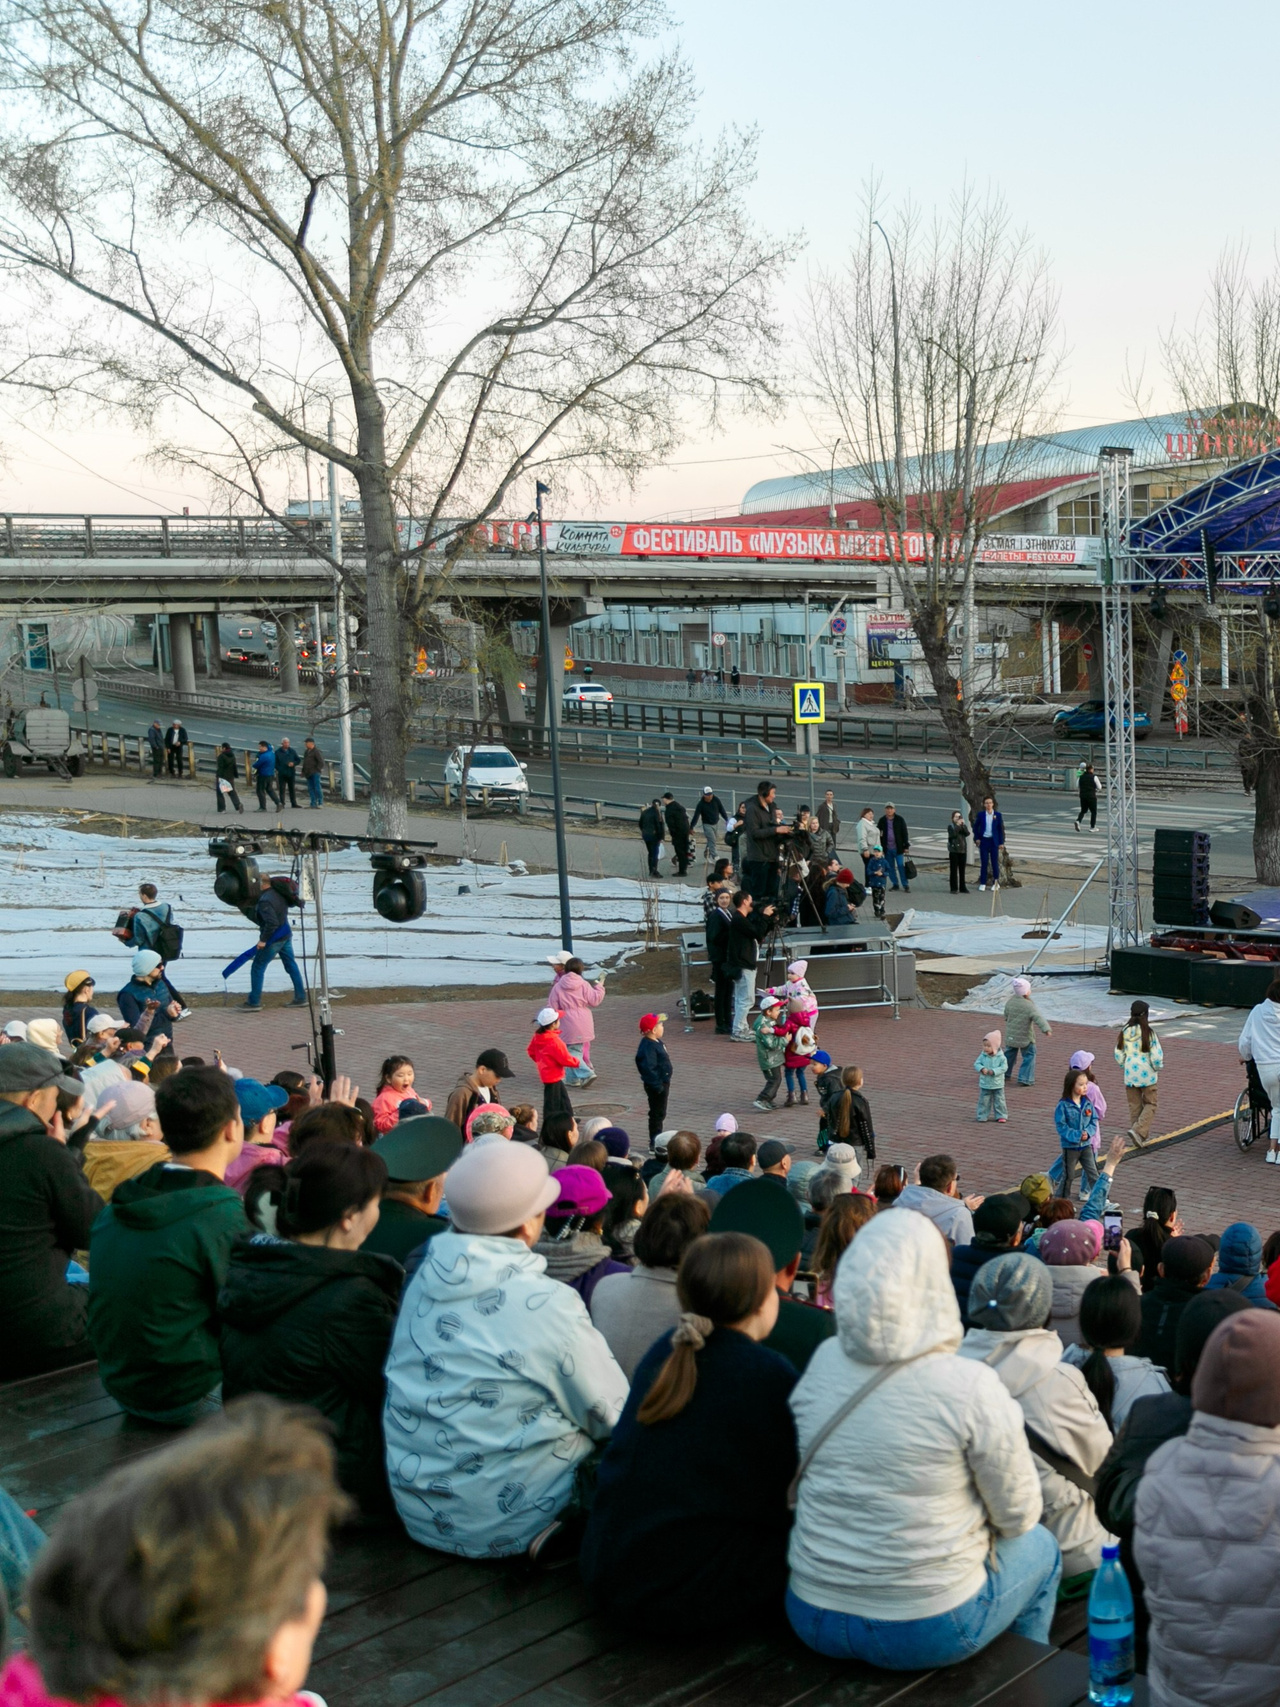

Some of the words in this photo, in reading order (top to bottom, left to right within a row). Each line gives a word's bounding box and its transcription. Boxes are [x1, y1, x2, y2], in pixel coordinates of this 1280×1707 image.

[633, 528, 743, 553] ФЕСТИВАЛЬ
[749, 530, 835, 556] «МУЗЫКА
[839, 532, 895, 558] МОЕГО
[998, 538, 1016, 550] МАЯ
[1025, 538, 1077, 551] ЭТНОМУЗЕЙ
[984, 551, 1025, 562] БИЛЕТЫ:
